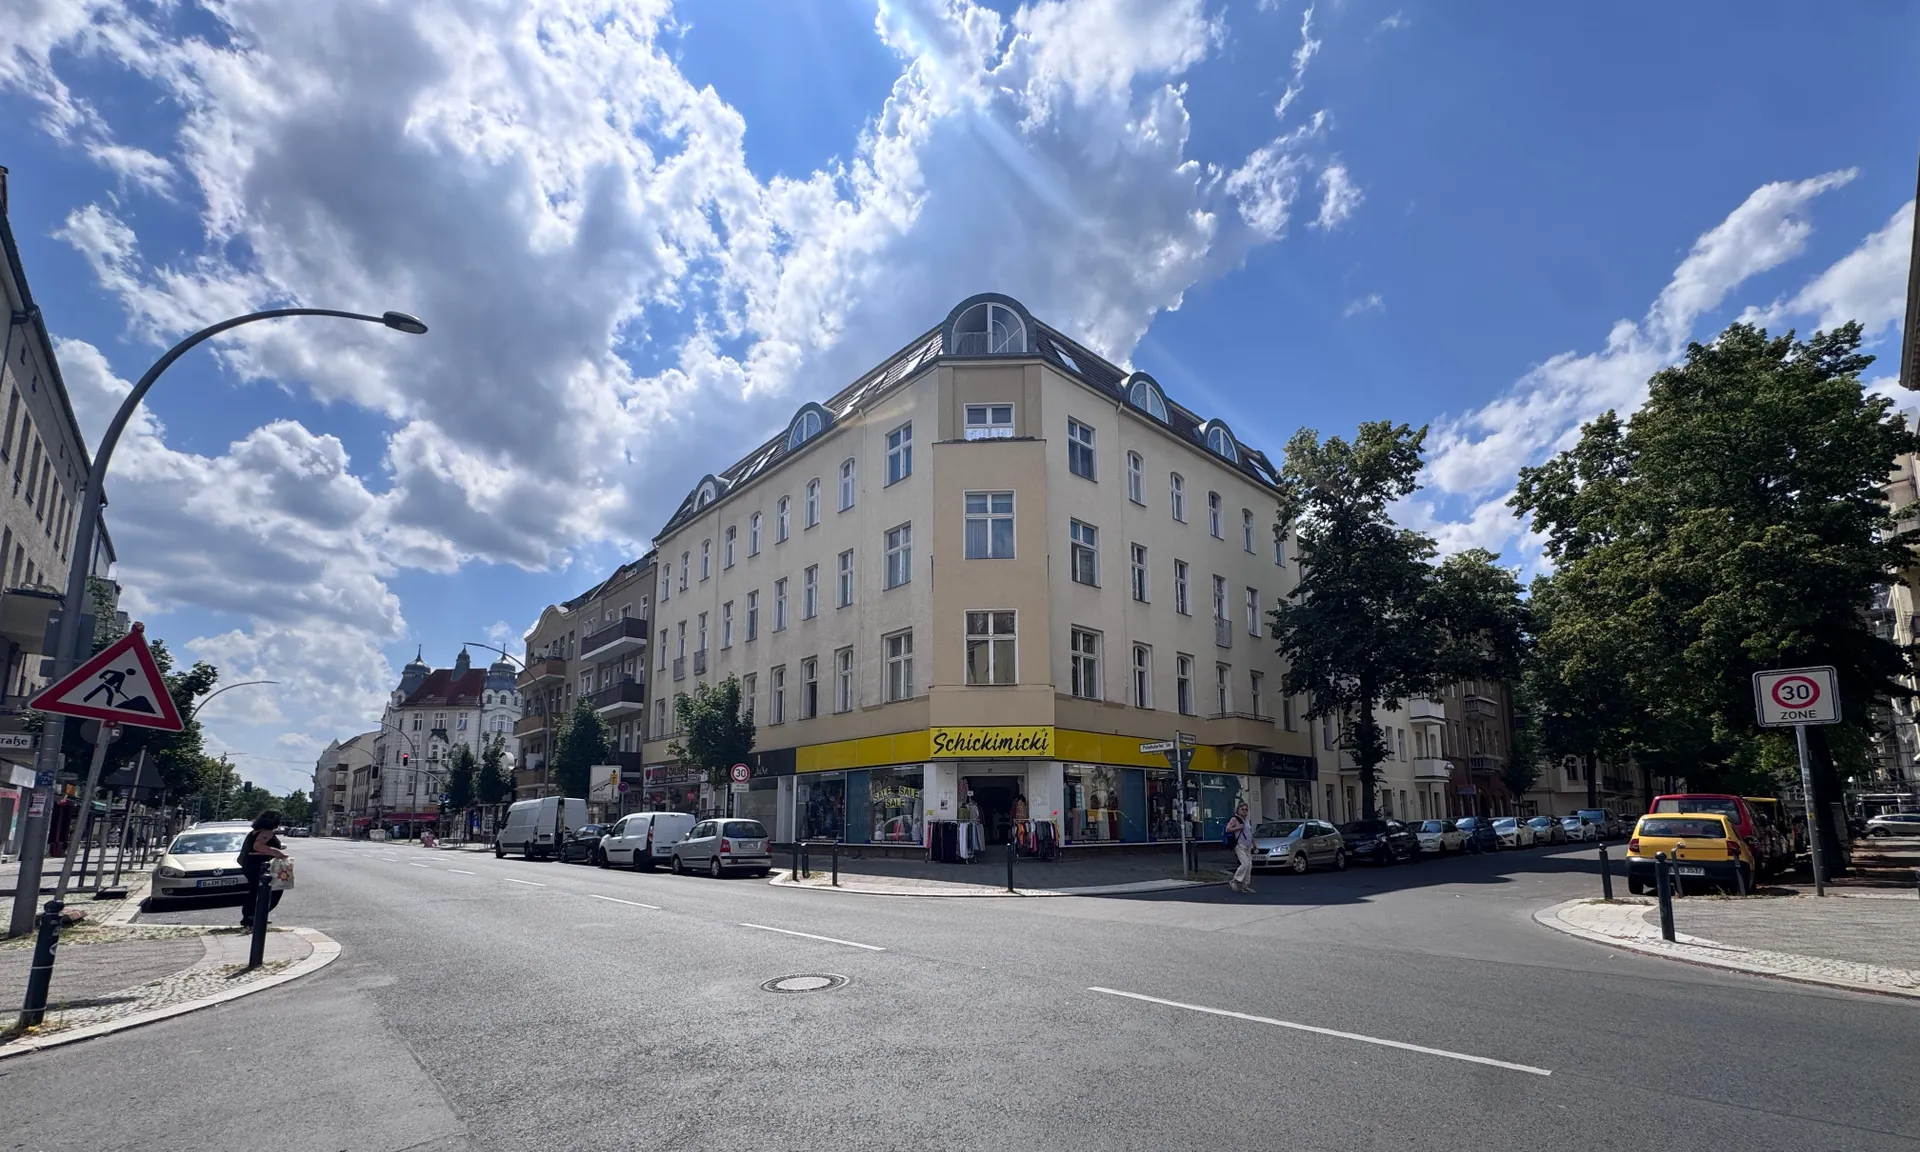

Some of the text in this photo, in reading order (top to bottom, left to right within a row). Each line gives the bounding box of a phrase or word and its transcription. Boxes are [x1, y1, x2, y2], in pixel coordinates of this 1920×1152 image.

[1781, 684, 1810, 701] 30
[1780, 710, 1817, 720] ZONE
[0, 736, 29, 747] raße
[933, 731, 1050, 755] Schickimicki
[735, 768, 747, 778] 30
[873, 786, 892, 803] SALE
[899, 786, 919, 798] SALE
[886, 798, 905, 808] SALE
